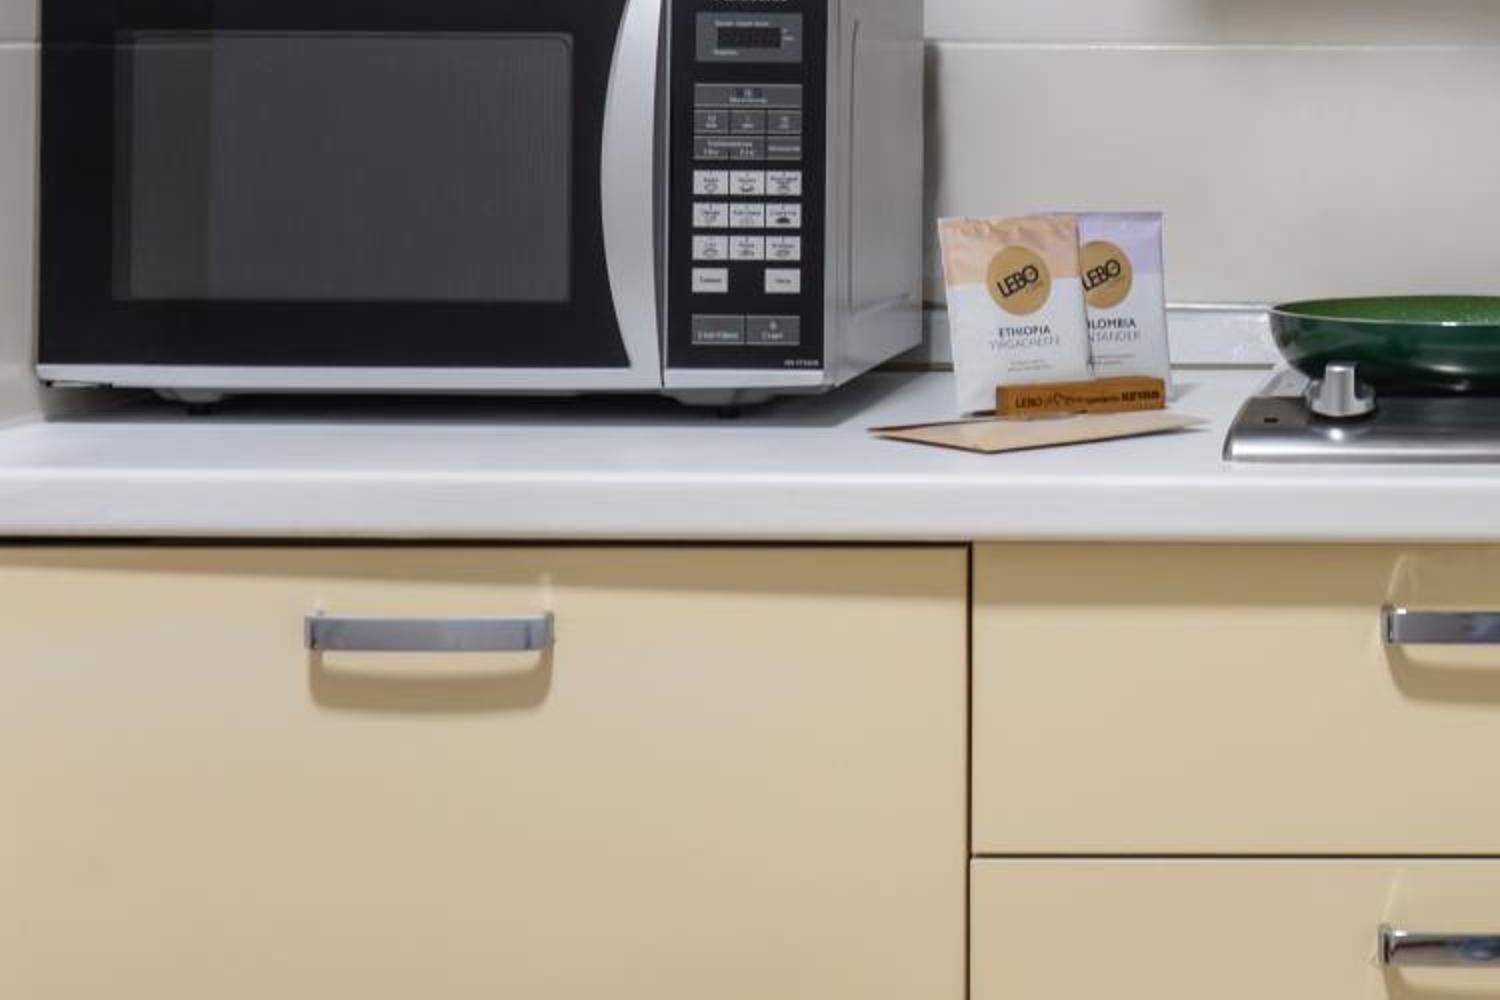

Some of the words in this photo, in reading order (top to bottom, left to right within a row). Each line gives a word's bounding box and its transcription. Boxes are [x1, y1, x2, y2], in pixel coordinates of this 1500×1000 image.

[997, 264, 1040, 298] LEBO
[1081, 258, 1121, 292] LEBO
[998, 324, 1051, 338] ETHIOPIA
